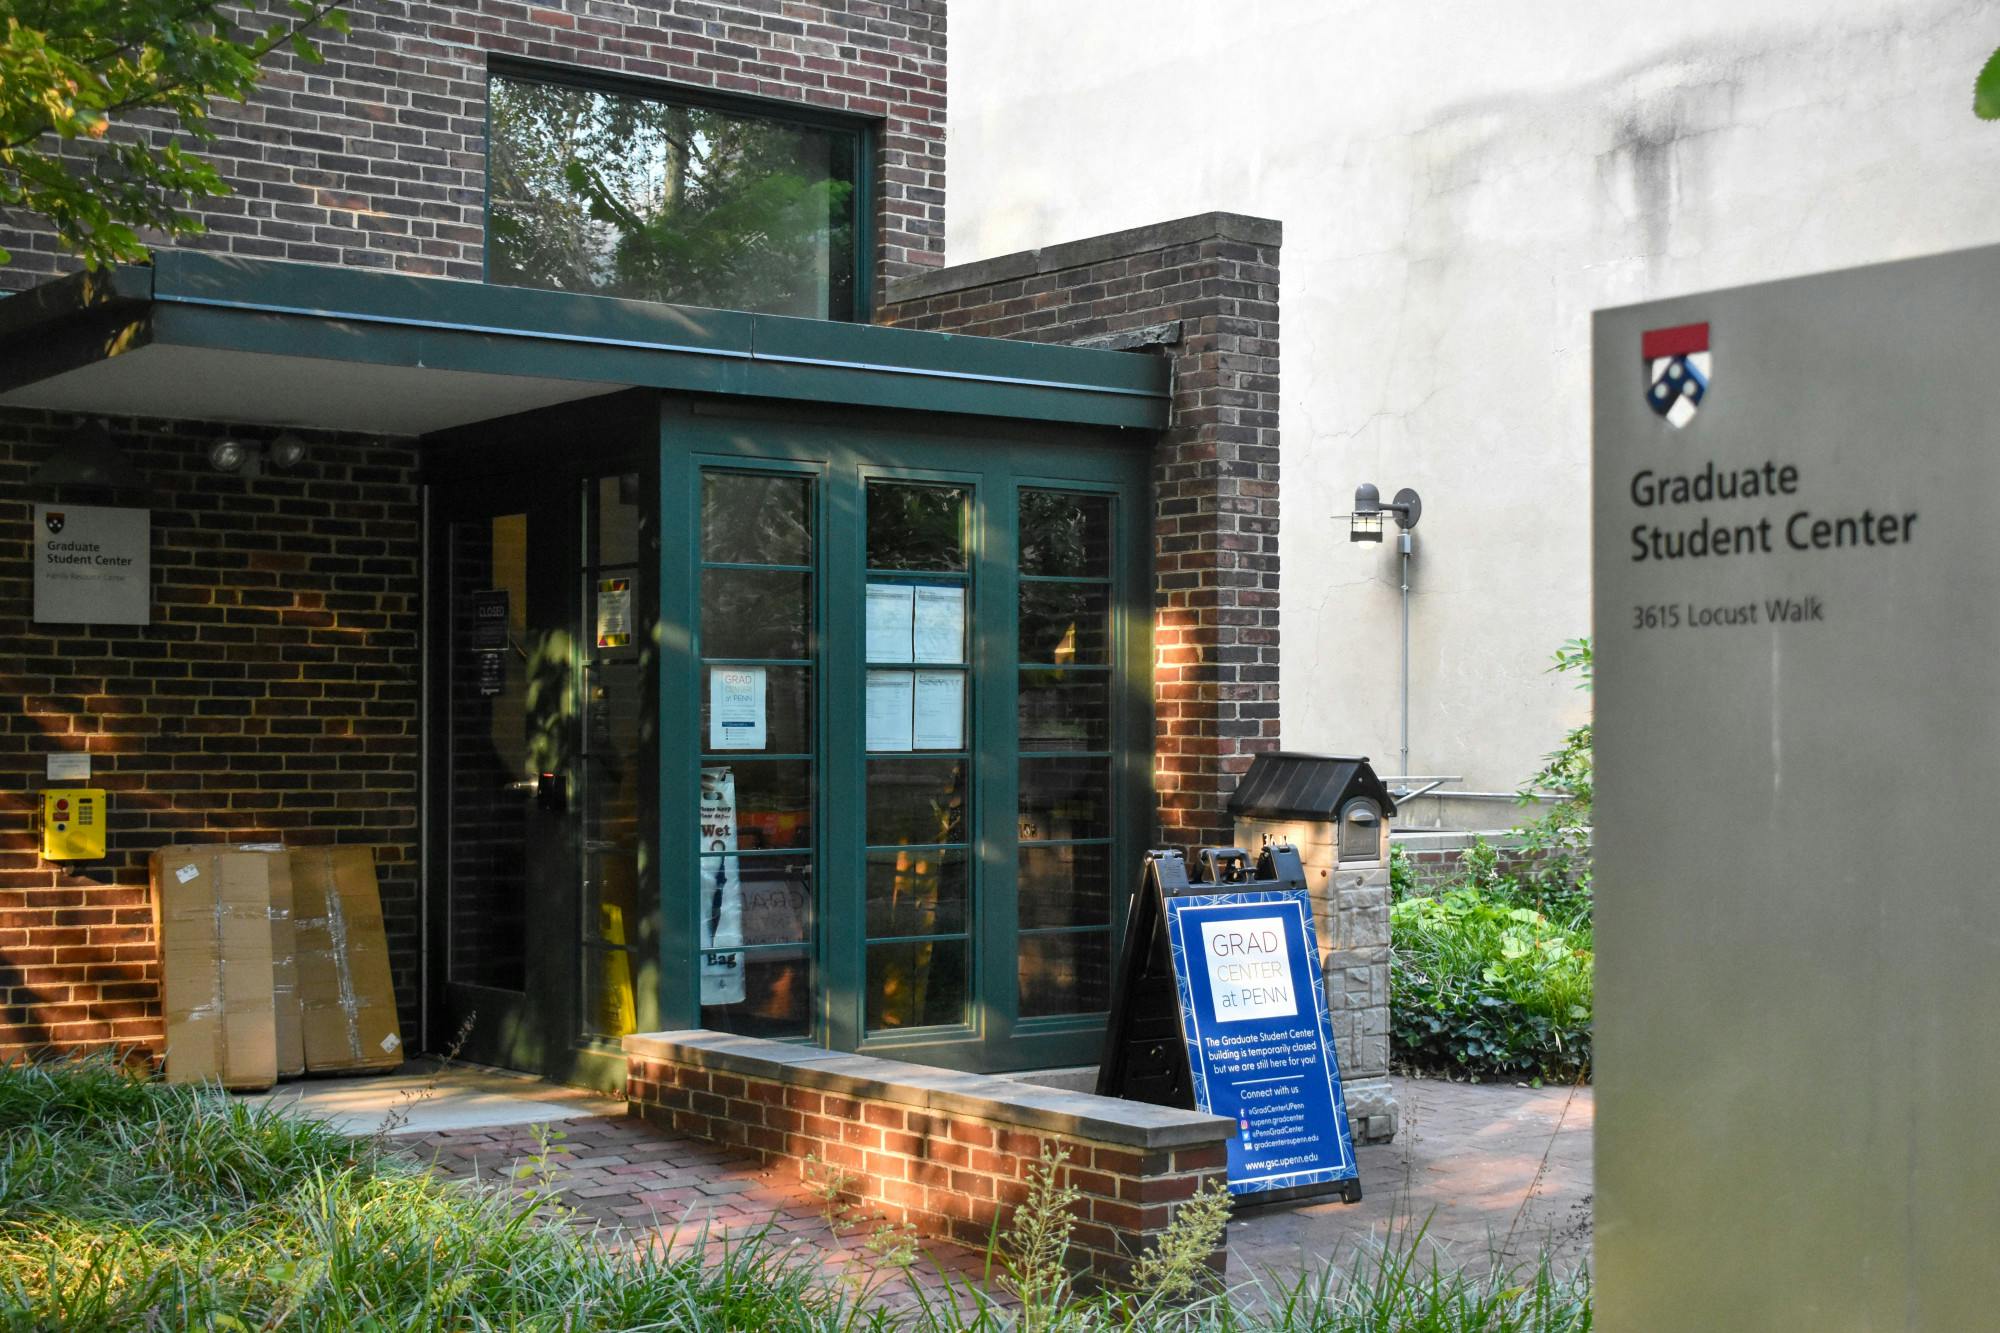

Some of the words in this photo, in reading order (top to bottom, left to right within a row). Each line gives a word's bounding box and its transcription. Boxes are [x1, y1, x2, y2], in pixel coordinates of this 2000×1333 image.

[1631, 460, 1798, 507] Graduate
[1631, 518, 1772, 562] Student
[1786, 509, 1918, 551] Center
[47, 541, 100, 552] Graduate
[47, 553, 92, 565] Student
[95, 555, 133, 566] Center
[479, 606, 505, 618] CLOSED
[1633, 604, 1680, 629] 3615
[1688, 601, 1757, 627] Locust
[1765, 596, 1824, 623] Walk
[725, 675, 752, 684] GRAD
[701, 824, 731, 837] Wet
[1212, 931, 1278, 956] GRAD
[707, 953, 737, 968] Bag
[1217, 960, 1283, 982] CENTER
[1222, 990, 1238, 1008] at
[1241, 985, 1288, 1006] PENN
[1205, 1037, 1220, 1048] The
[1221, 1034, 1258, 1046] Graduate
[1259, 1030, 1288, 1042] Student
[1289, 1029, 1315, 1039] Center
[1208, 1049, 1240, 1060] building
[1240, 1048, 1247, 1057] is
[1248, 1044, 1291, 1057] temporarily
[1292, 1041, 1317, 1052] closed
[1213, 1064, 1227, 1074] but
[1228, 1064, 1240, 1072] we
[1242, 1062, 1255, 1071] are
[1256, 1059, 1269, 1069] still
[1270, 1058, 1287, 1068] here
[1288, 1056, 1300, 1066] for
[1300, 1054, 1316, 1067] you!
[1240, 1089, 1273, 1099] Connect
[1274, 1086, 1290, 1096] with
[1291, 1086, 1299, 1094] us
[1245, 1152, 1319, 1170] www.gsc.upenn.edu
